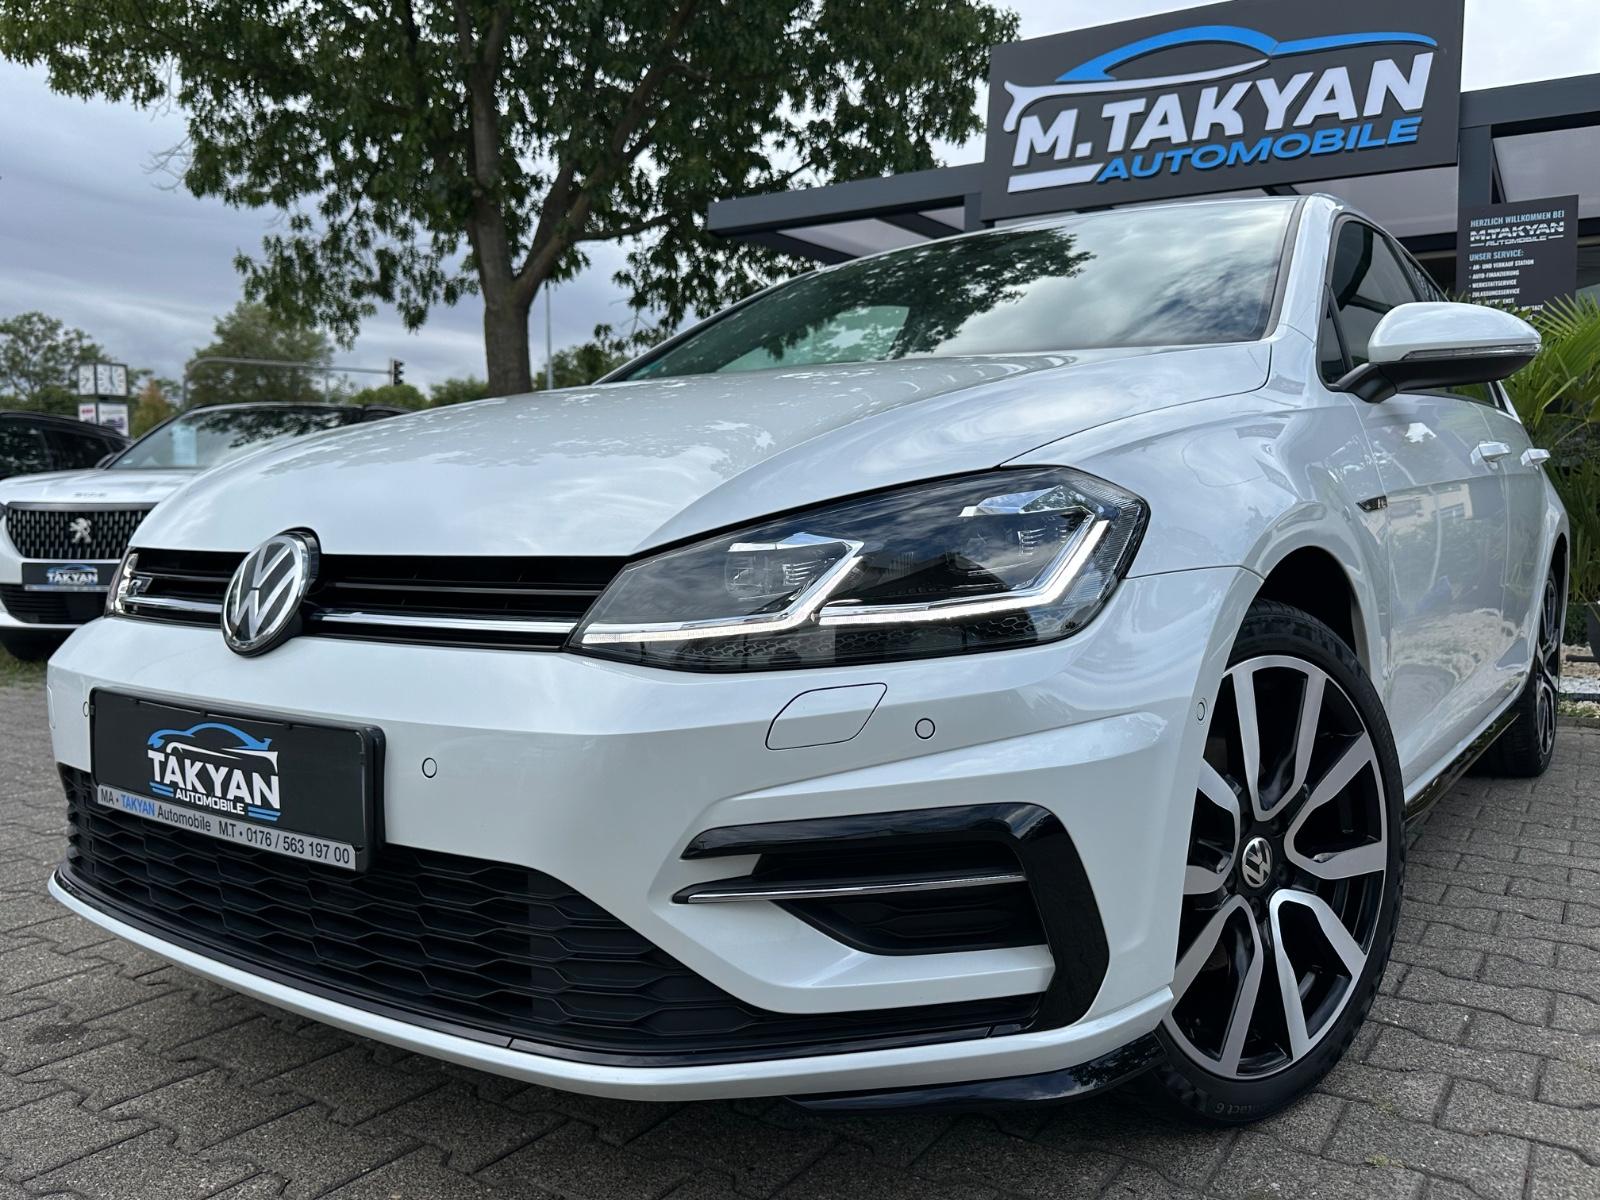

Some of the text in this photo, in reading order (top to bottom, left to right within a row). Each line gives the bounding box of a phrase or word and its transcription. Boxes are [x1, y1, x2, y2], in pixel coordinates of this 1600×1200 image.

[1012, 52, 1434, 167] M.TAKYAN
[1096, 116, 1423, 184] AUTOMOBILE
[1470, 210, 1565, 228] HERZLICH WILLKOMMEN BEI
[1470, 221, 1565, 241] M.TAKYAN
[1485, 235, 1547, 247] AUTOMOBILE
[1469, 249, 1524, 262] UNSER SERVICE:
[1493, 261, 1514, 269] VERKAUF
[47, 571, 98, 586] TAKYAN
[148, 750, 281, 809] TAKYAN
[175, 788, 245, 815] AUTOMOBILE
[101, 788, 115, 806] MA
[121, 794, 155, 816] TAKYAN
[157, 806, 211, 832] Automobile
[246, 827, 272, 847] 0176
[283, 836, 305, 854] 563
[309, 841, 330, 860] 197
[334, 846, 350, 864] 00
